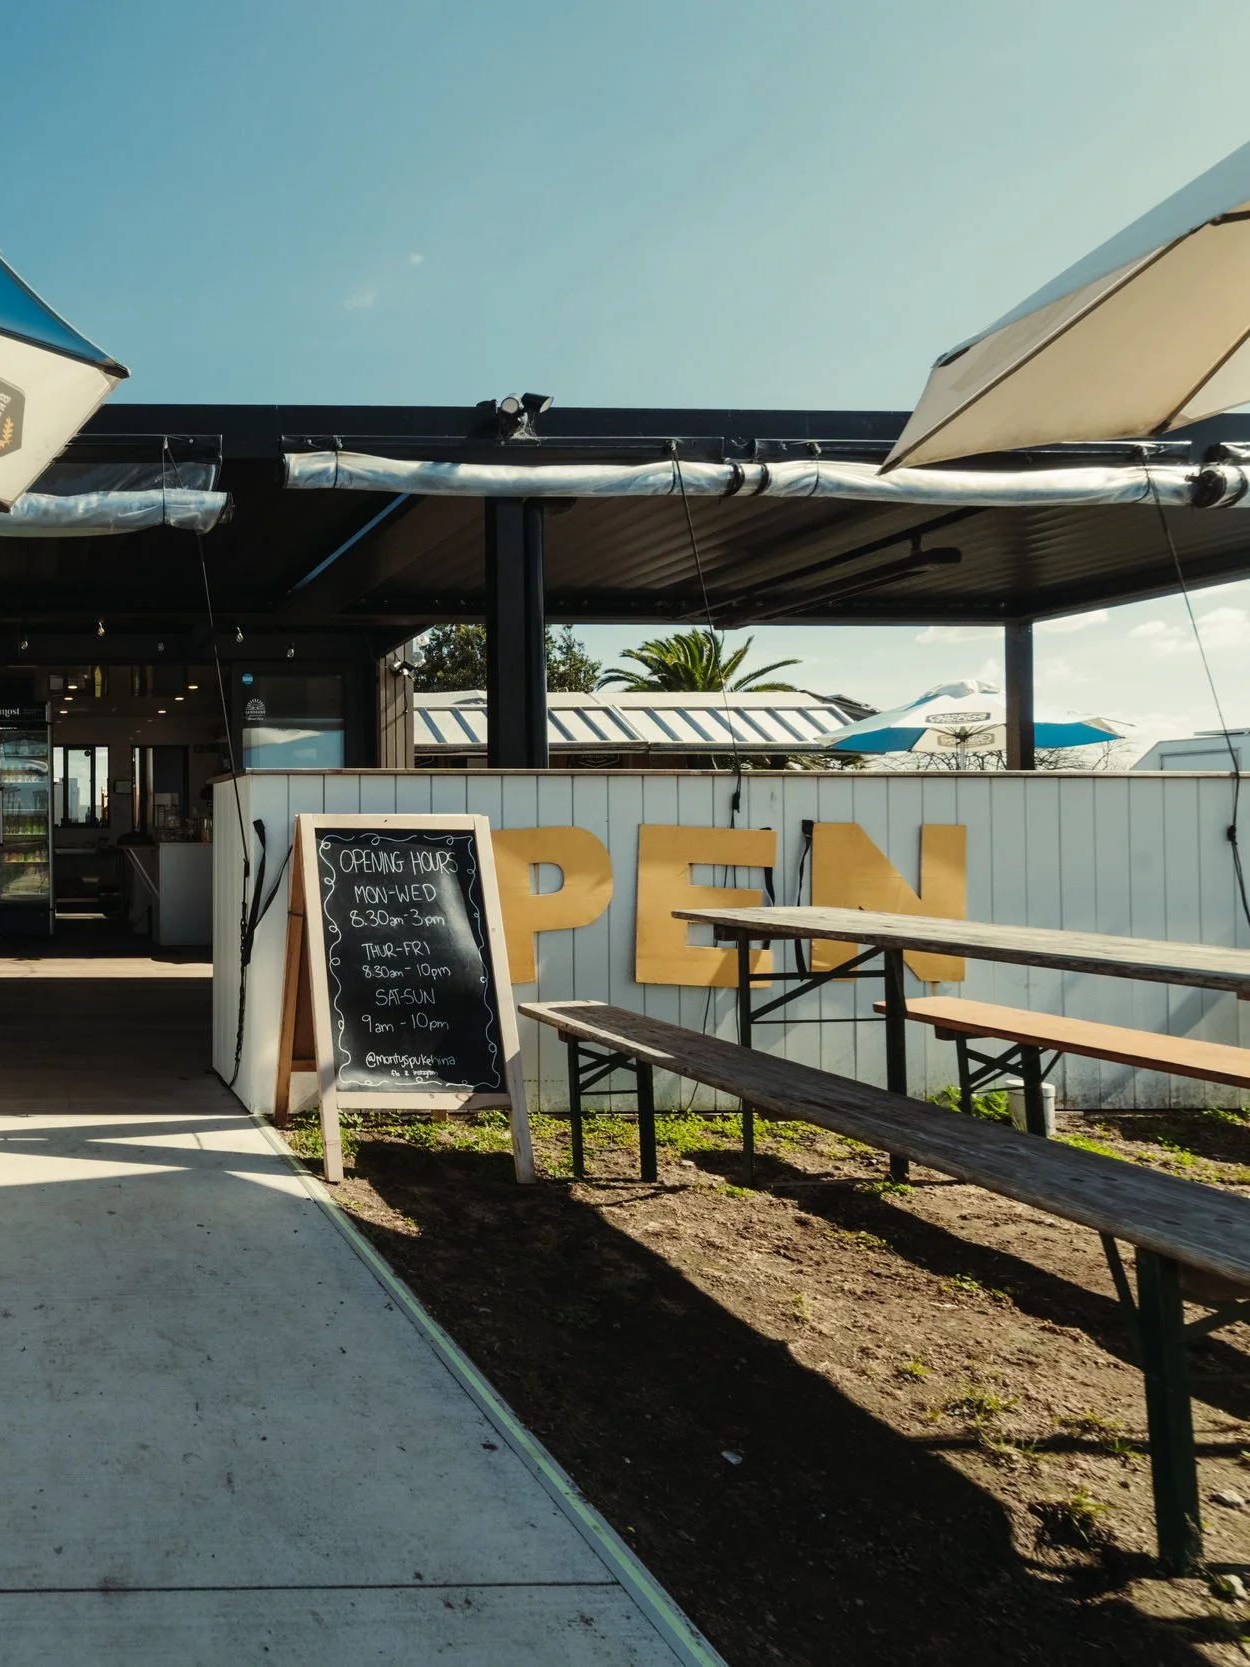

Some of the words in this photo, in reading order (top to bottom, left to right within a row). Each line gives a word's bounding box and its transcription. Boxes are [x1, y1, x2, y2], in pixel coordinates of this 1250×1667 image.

[339, 848, 405, 875] OPENING
[409, 850, 459, 876] HOURS
[354, 883, 437, 904] MON-WED
[361, 940, 431, 961] THUR-FRI
[416, 962, 452, 980] 10pm
[374, 987, 436, 1007] SAT-SUN
[361, 1013, 395, 1033] 9am
[411, 1011, 450, 1032] 10pm
